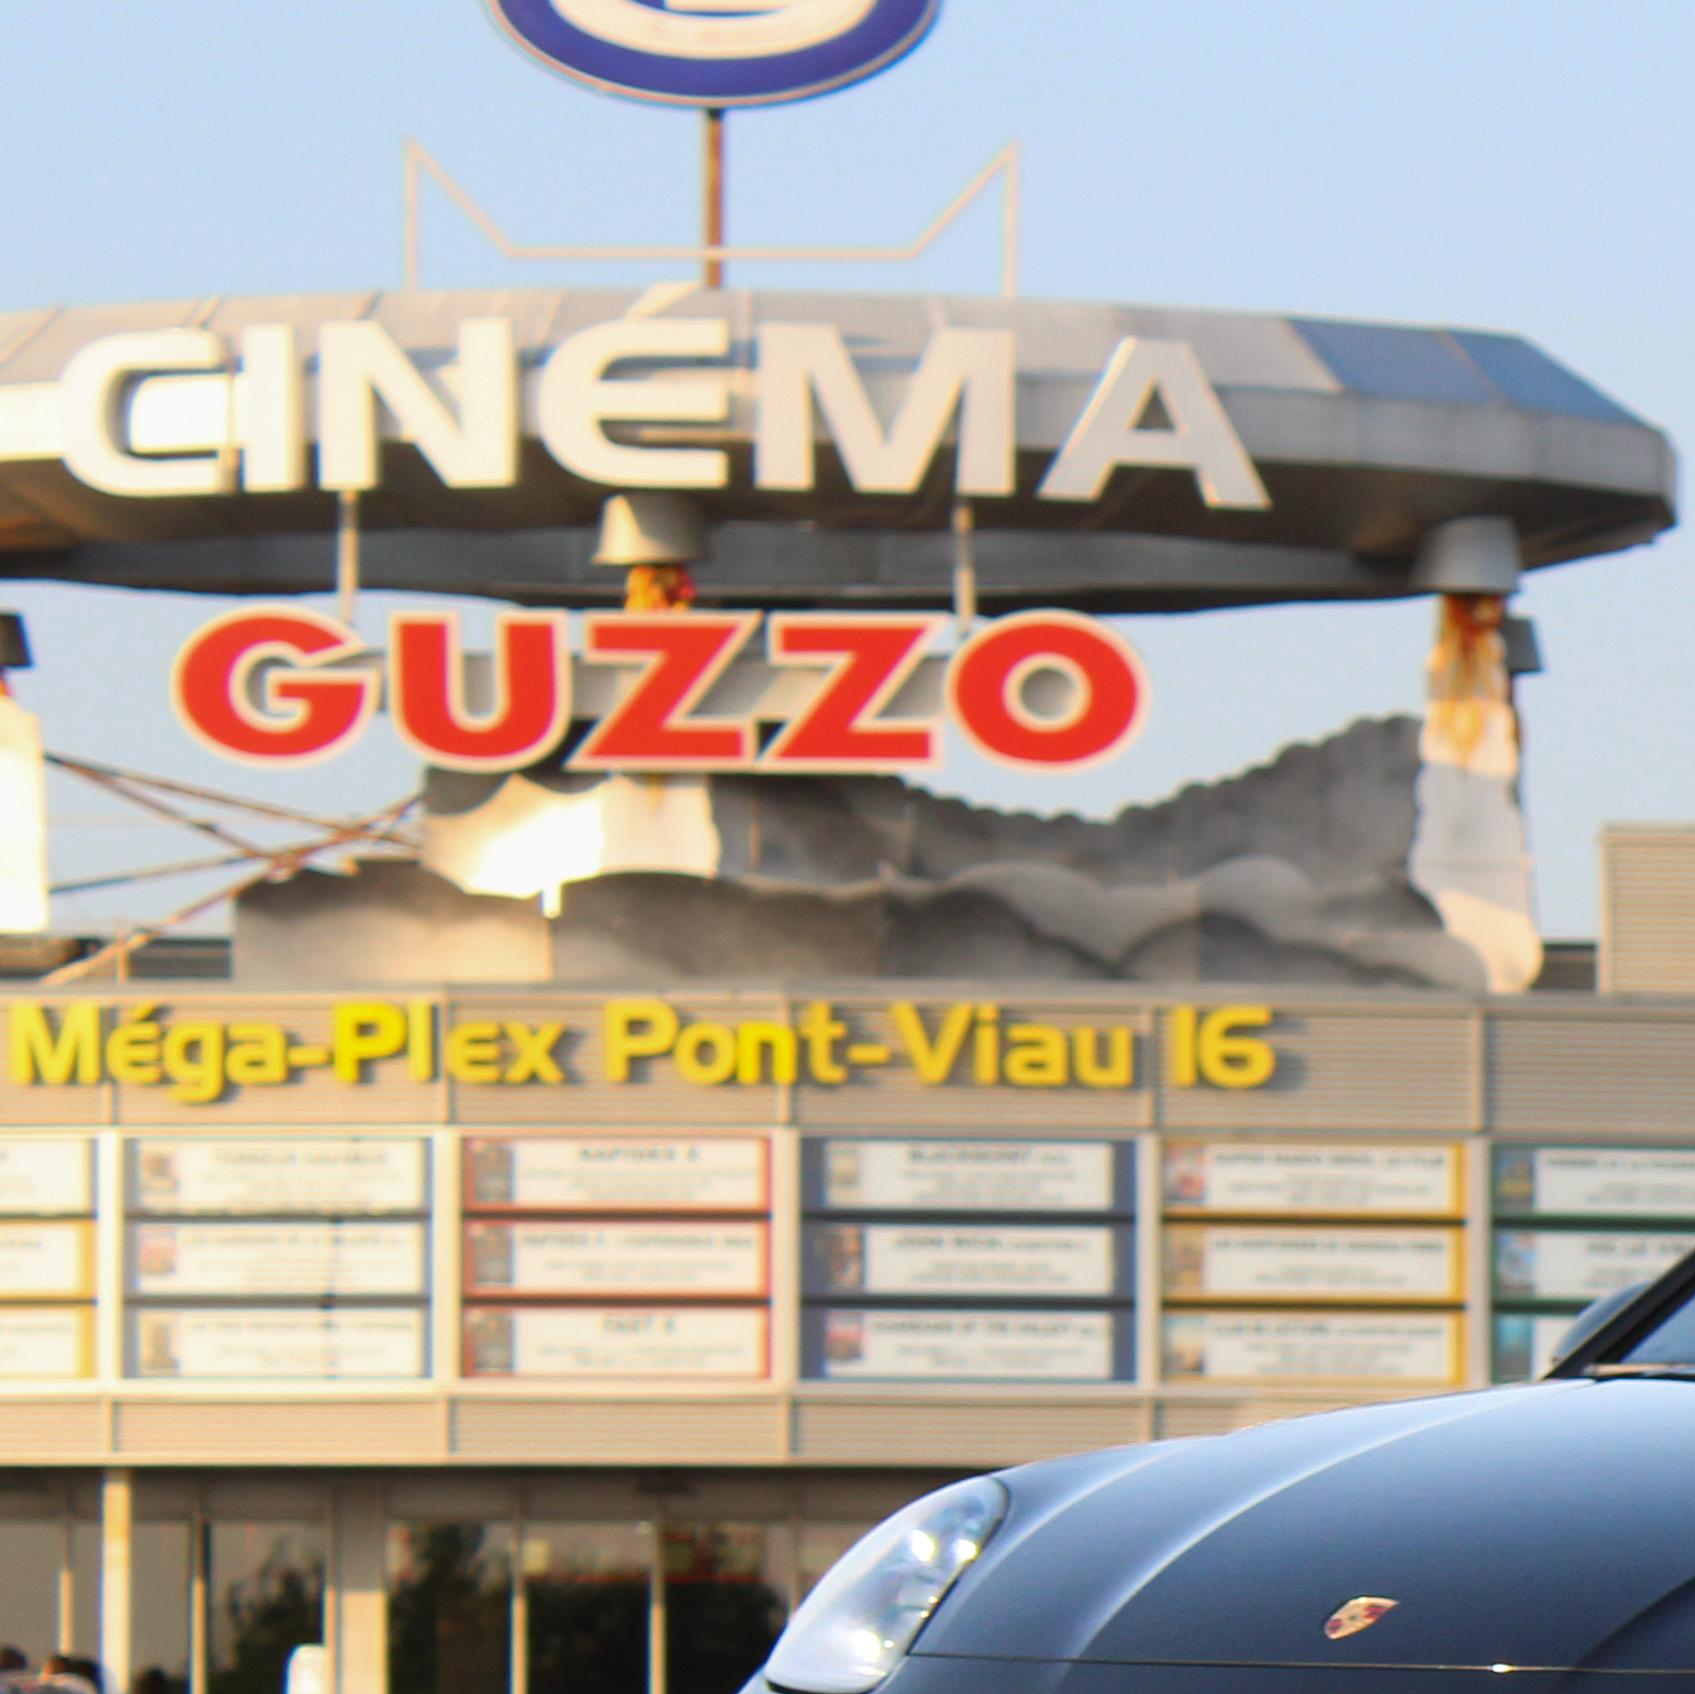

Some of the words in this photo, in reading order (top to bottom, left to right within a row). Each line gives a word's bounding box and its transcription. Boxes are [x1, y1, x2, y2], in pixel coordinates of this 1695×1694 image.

[57, 281, 1272, 511] CINÉMA
[170, 603, 1150, 775] GUZZO
[8, 998, 567, 1105] Méga-Plex
[604, 998, 1134, 1088] Pont-Viau
[1171, 1003, 1276, 1089] 16
